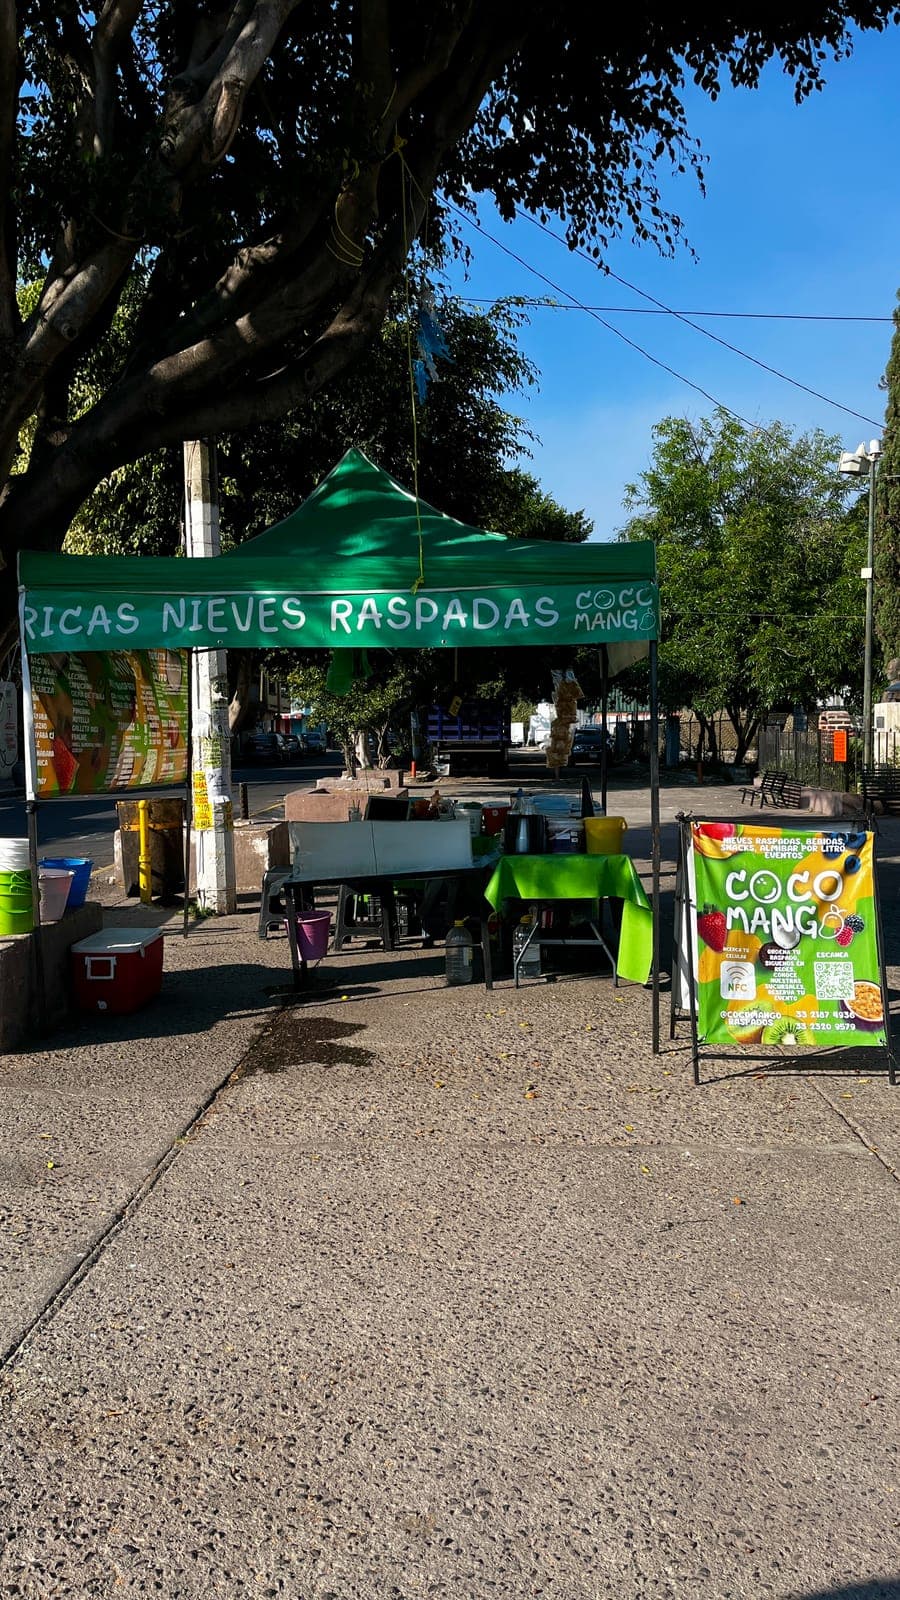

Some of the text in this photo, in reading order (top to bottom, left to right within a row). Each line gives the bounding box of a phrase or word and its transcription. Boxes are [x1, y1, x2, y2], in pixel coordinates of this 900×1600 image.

[24, 597, 559, 639] RICAS NIEVES RASPADAS
[723, 837, 752, 845] NIEVES
[755, 837, 801, 846] RASPADAS,
[721, 844, 757, 852] SNACKS,
[760, 844, 799, 852] ALMIBAR
[725, 869, 843, 904] COCO
[726, 904, 847, 940] MANGO
[728, 983, 747, 992] NFC
[720, 1010, 782, 1020] @COCOMANGO
